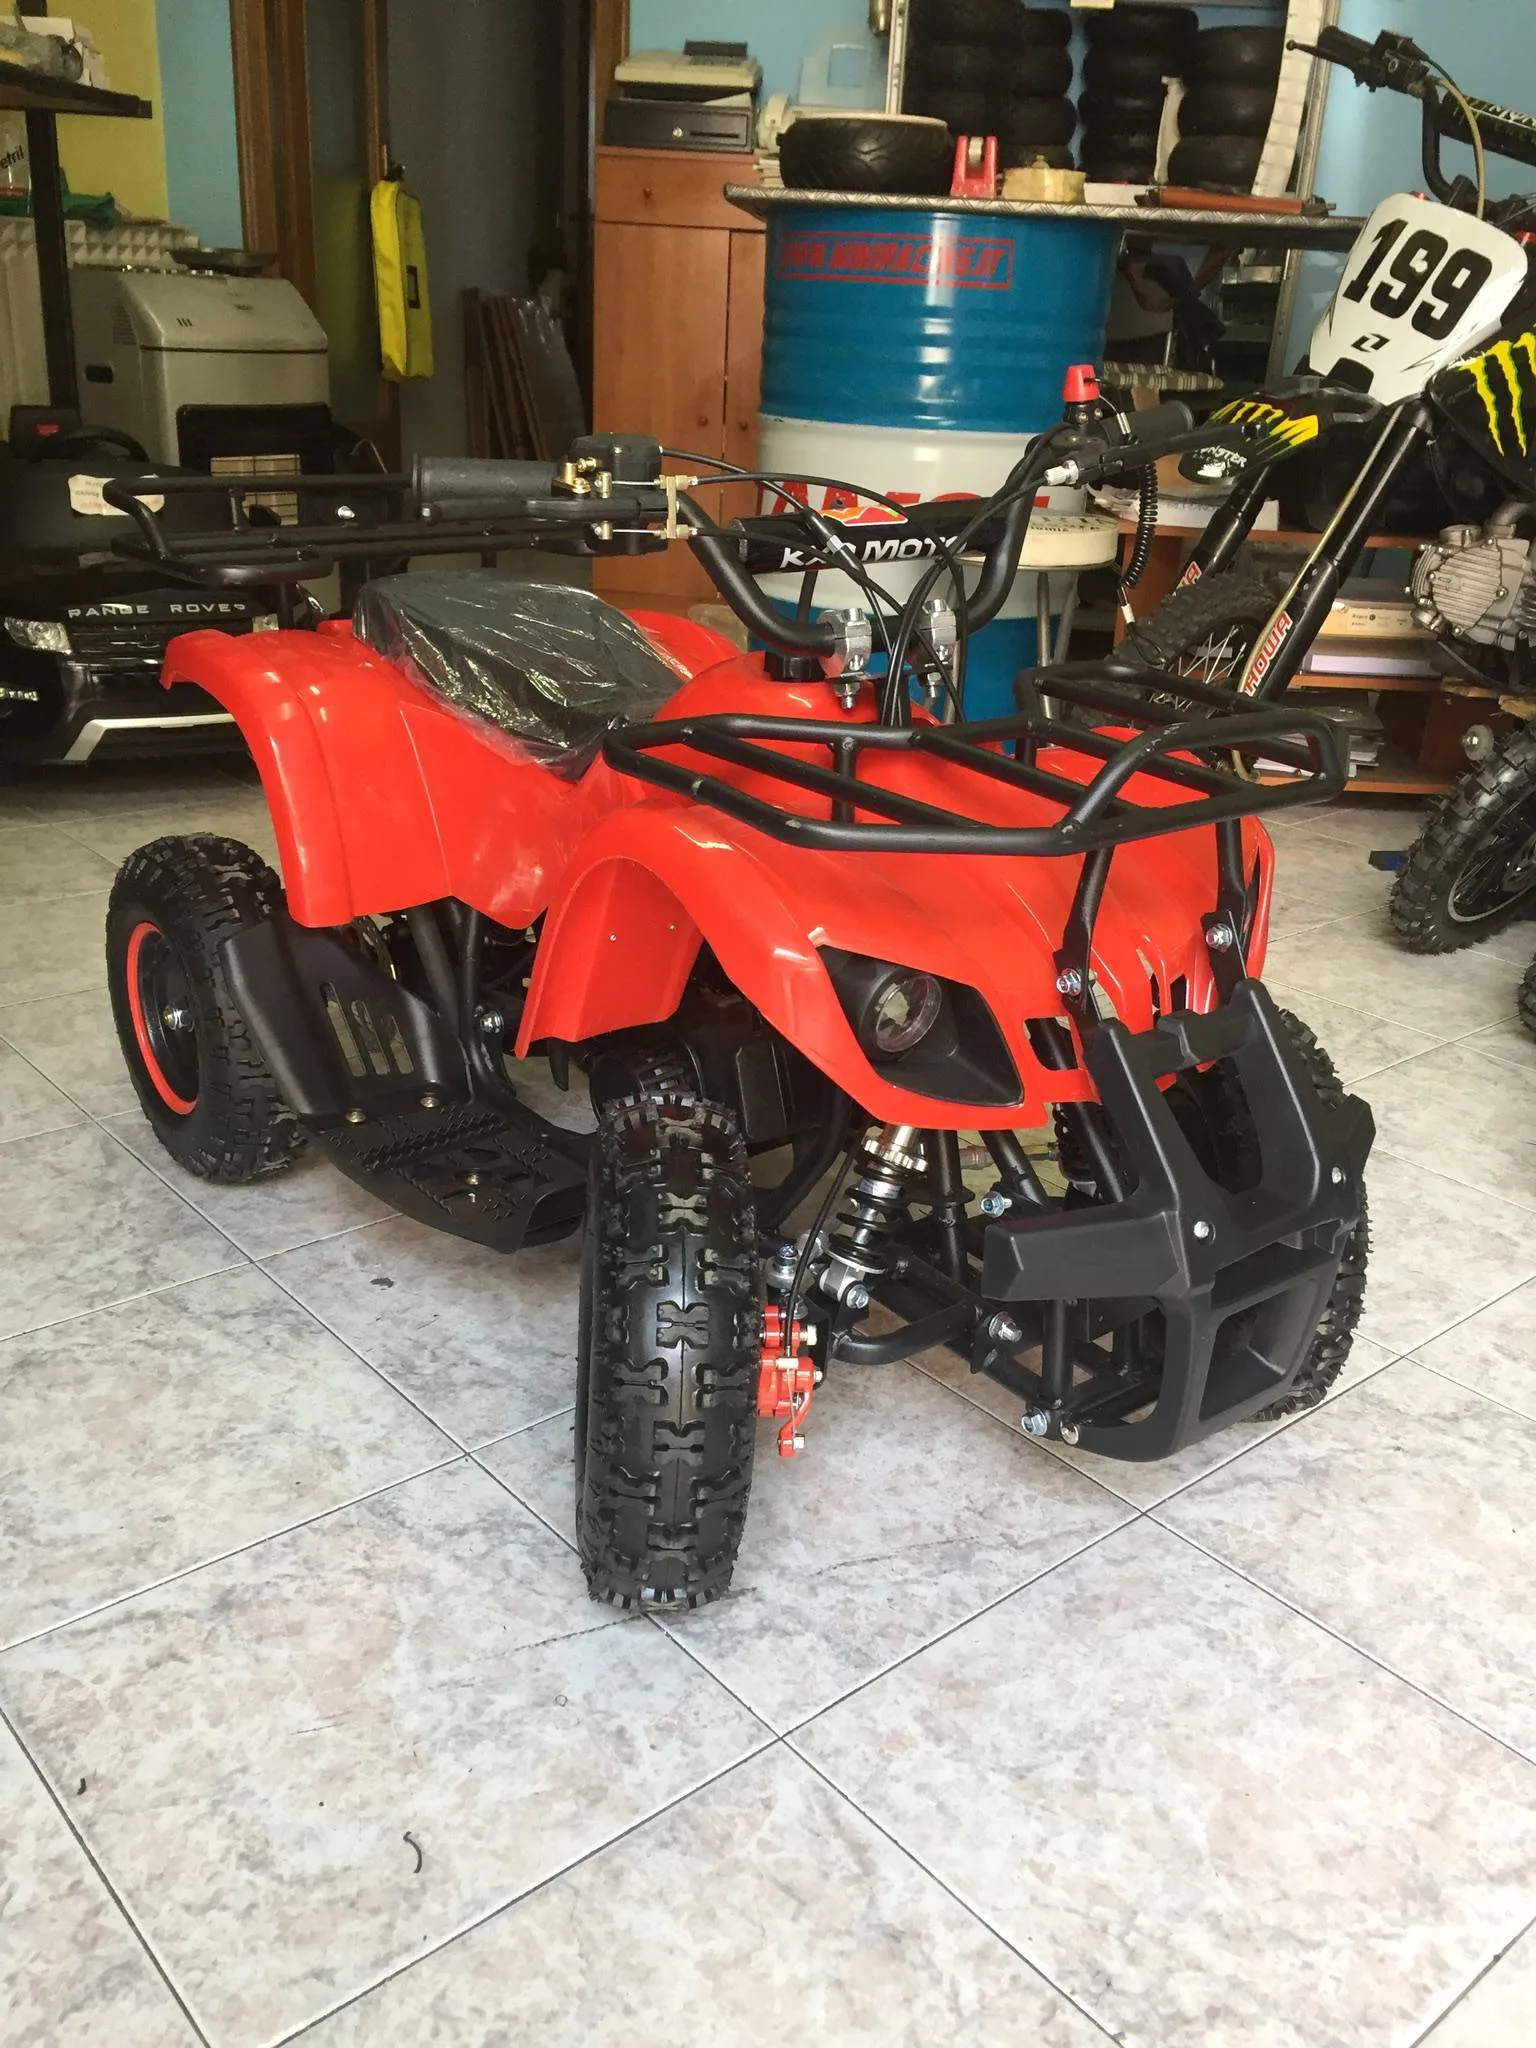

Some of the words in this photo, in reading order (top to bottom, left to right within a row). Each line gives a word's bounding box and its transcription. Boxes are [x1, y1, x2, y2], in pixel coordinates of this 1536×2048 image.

[1341, 218, 1493, 341] 199
[67, 604, 150, 619] RANGE
[1245, 610, 1294, 697] HOWA
